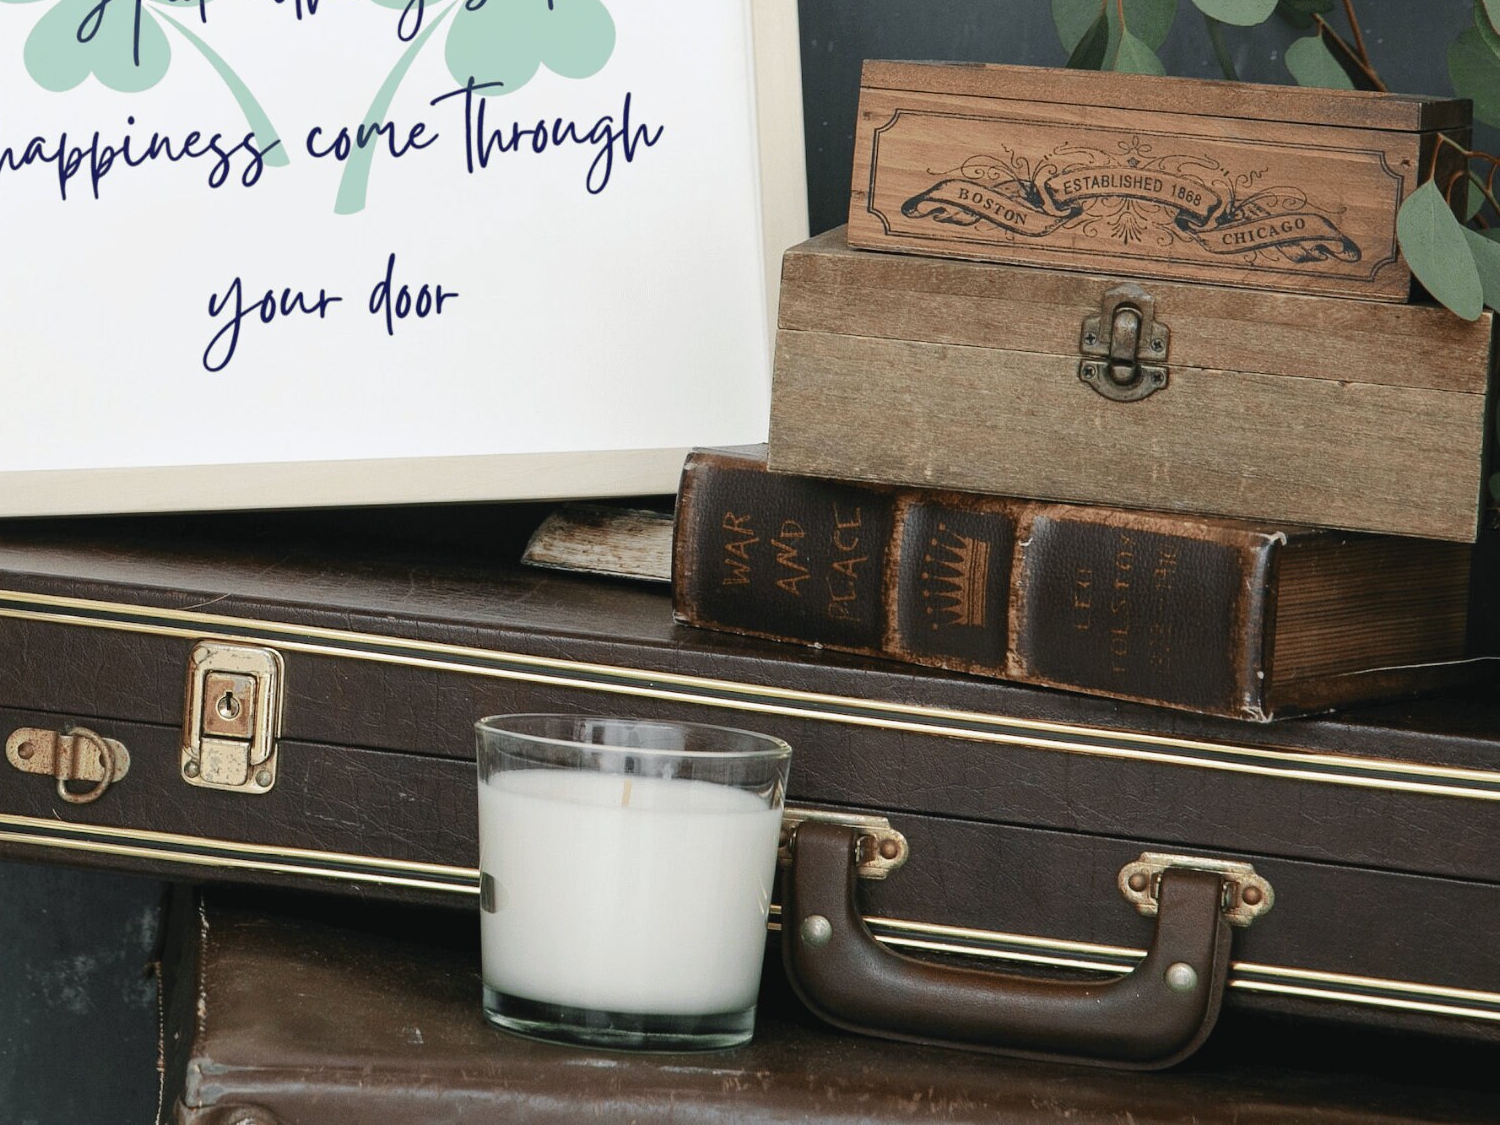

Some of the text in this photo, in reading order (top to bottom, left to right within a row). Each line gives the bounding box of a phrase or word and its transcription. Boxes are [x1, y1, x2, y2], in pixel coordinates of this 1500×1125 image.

[305, 120, 440, 162] come
[429, 75, 665, 195] through
[957, 187, 1029, 227] BOSTON
[1062, 174, 1203, 207] ESTABLISHED 1868
[1221, 217, 1306, 246] CHICAGO
[202, 251, 460, 373] your door
[721, 510, 761, 586] WAR
[769, 518, 812, 597] AND
[825, 501, 870, 623] PEACE
